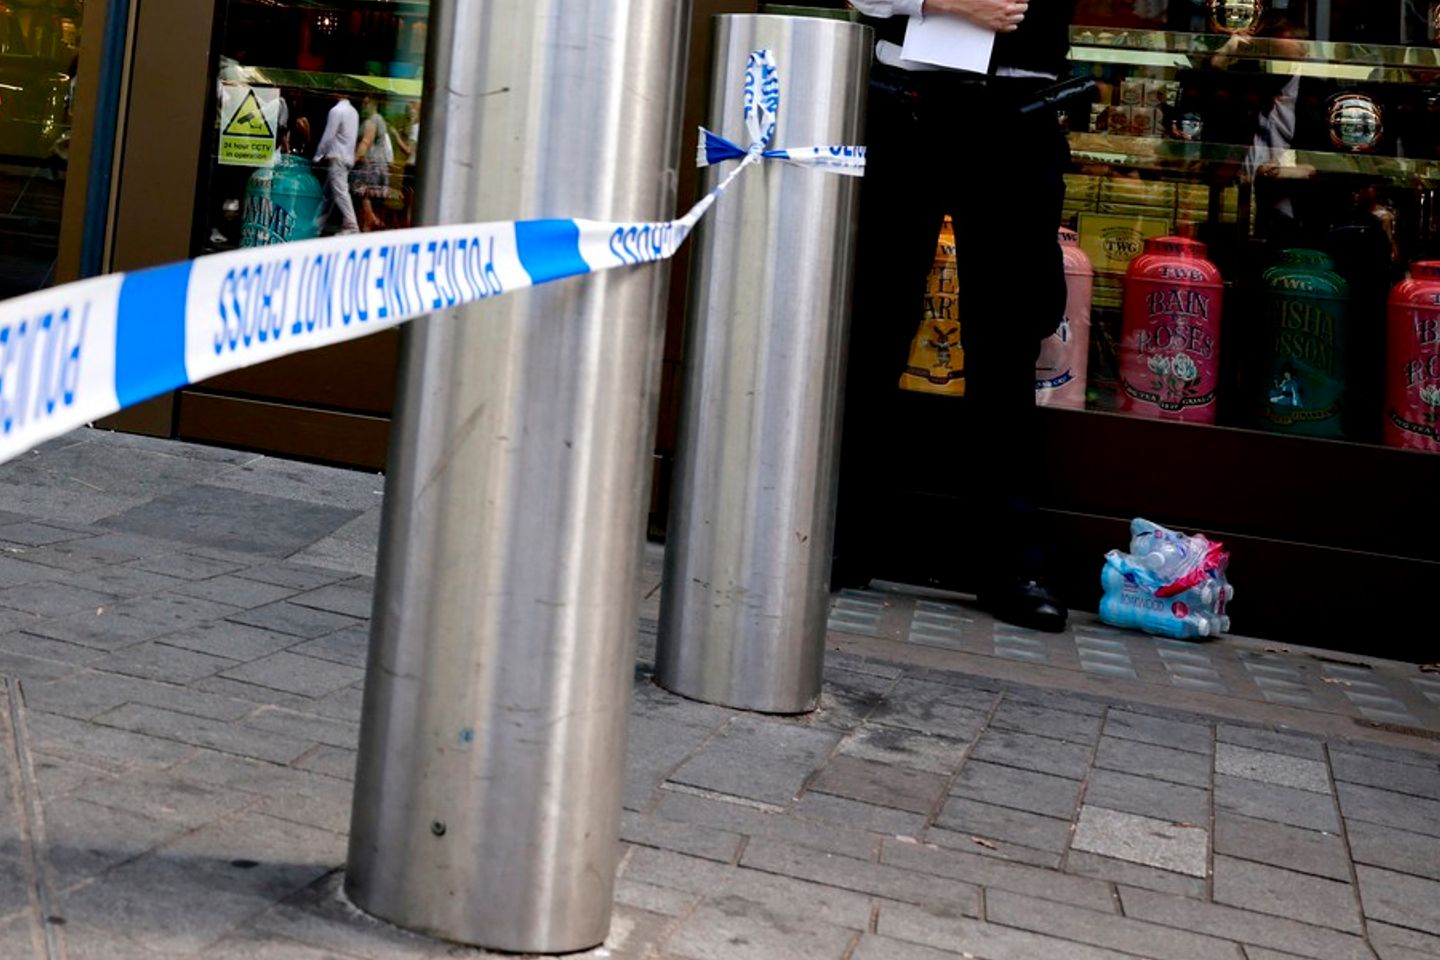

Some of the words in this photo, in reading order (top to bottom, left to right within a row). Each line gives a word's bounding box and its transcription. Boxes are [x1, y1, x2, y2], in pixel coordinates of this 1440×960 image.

[233, 142, 250, 150] hour
[251, 143, 272, 152] CCTV
[233, 152, 267, 160] operation
[1106, 240, 1138, 253] TWG
[341, 248, 373, 326] DO
[376, 242, 425, 319] LINE
[426, 235, 503, 309] POLICE
[1160, 266, 1203, 282] TWG
[1271, 275, 1313, 290] TWG
[213, 258, 292, 356] CROSS
[291, 251, 341, 336] NOT
[1145, 288, 1210, 320] BAIN
[1273, 299, 1336, 343] ISHA
[1136, 325, 1215, 360] ROSES
